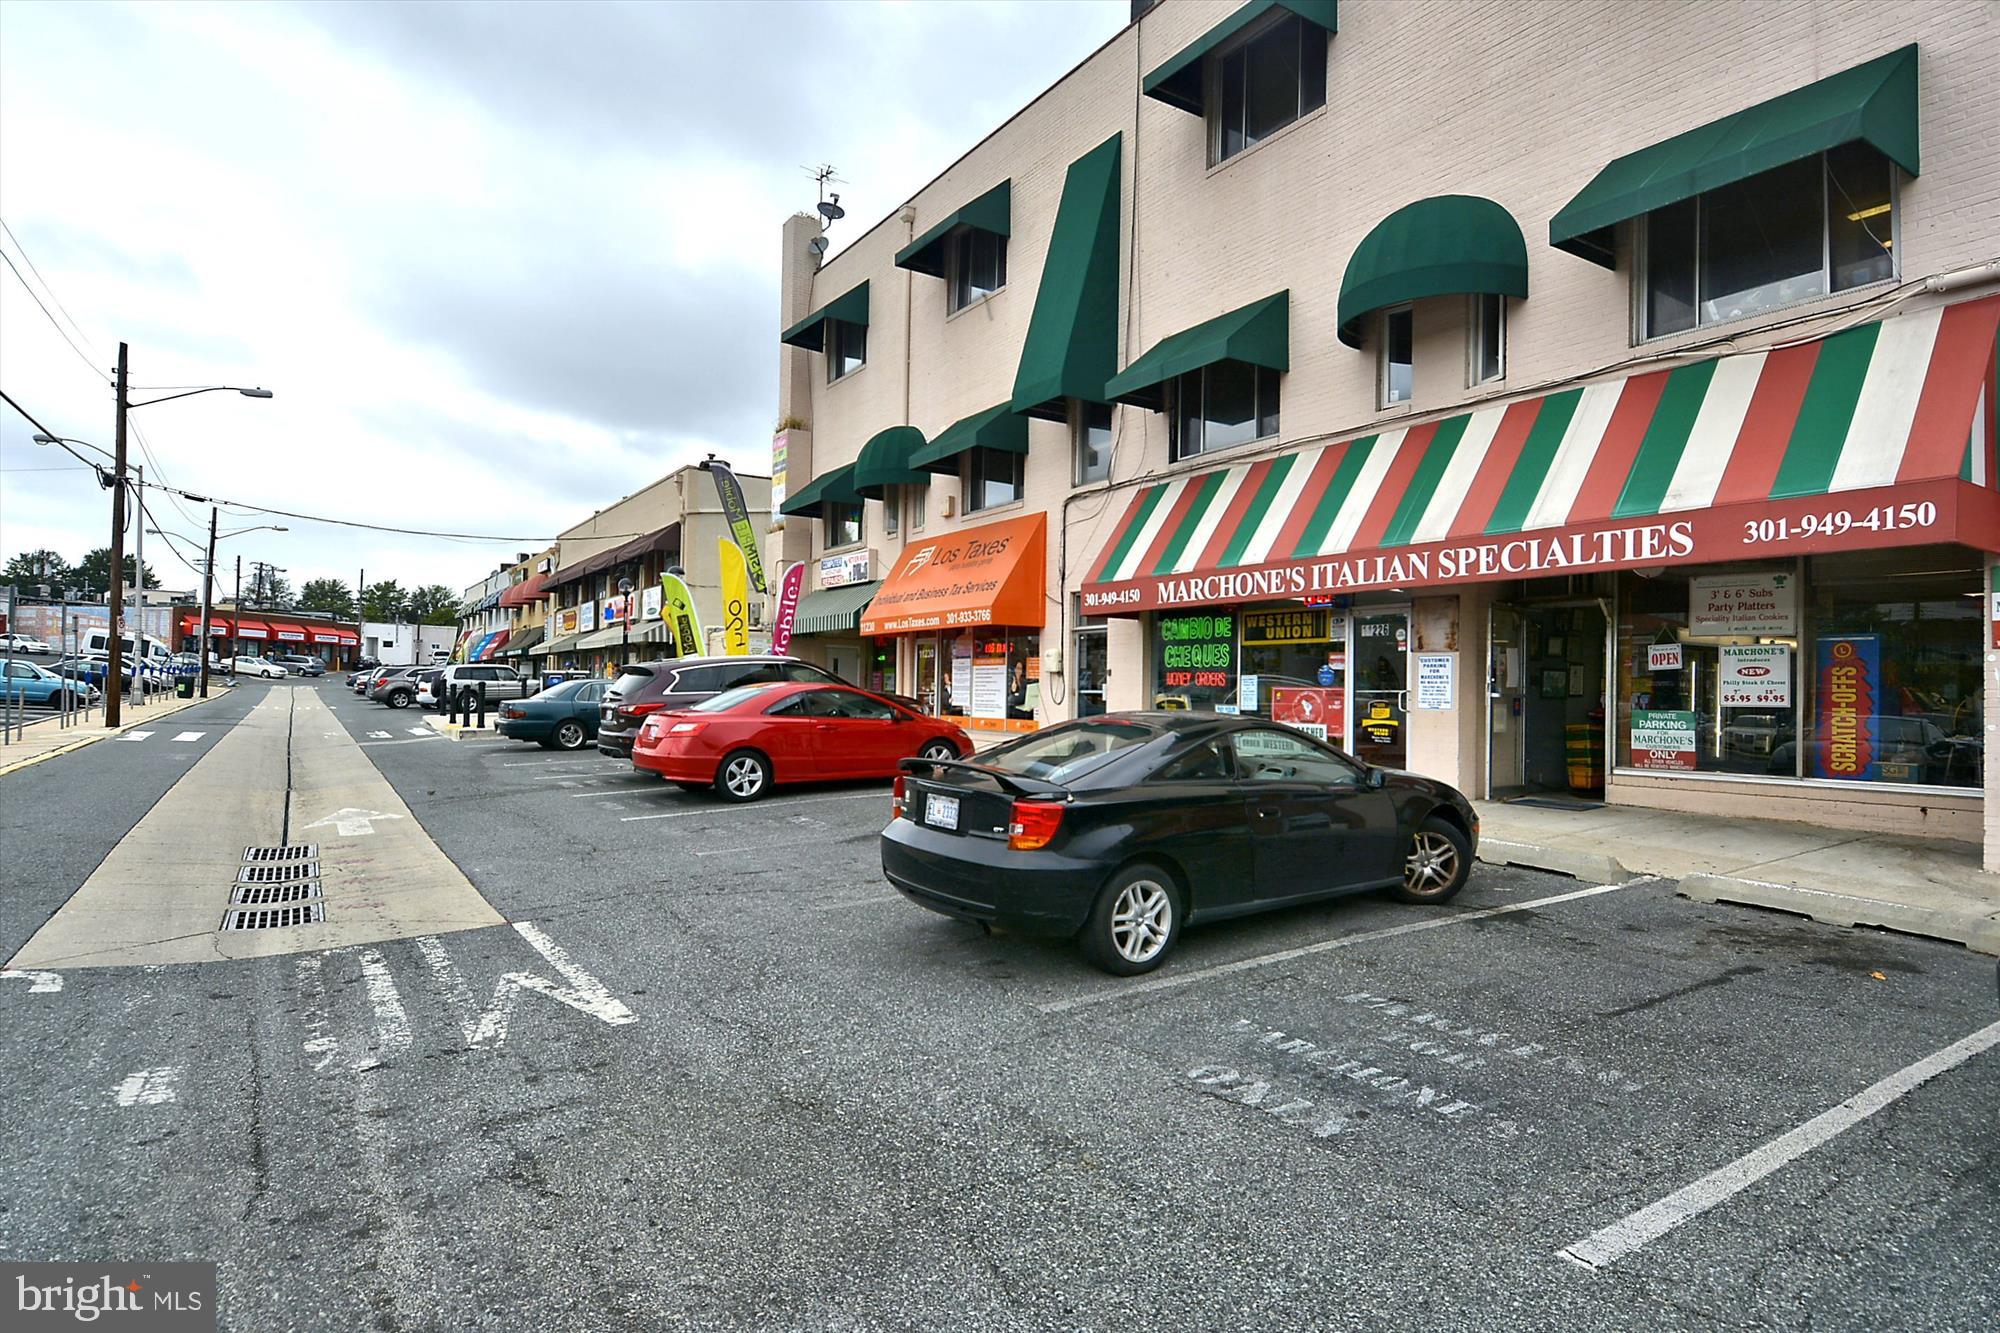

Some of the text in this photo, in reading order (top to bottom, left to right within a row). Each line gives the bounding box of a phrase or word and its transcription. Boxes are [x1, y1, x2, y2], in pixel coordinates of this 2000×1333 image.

[1743, 501, 1937, 544] 301-949-4150
[931, 546, 961, 566] Los
[963, 537, 1010, 560] Taxes
[1157, 520, 1695, 604] MARCHONE'S ITALIAN SPECIALTIES
[875, 592, 906, 606] Individual
[916, 587, 950, 600] Business
[948, 583, 963, 596] Tax
[962, 580, 998, 594] Services
[1084, 588, 1141, 607] 301-949-4150
[1749, 588, 1773, 598] Subs
[1708, 601, 1776, 613] Party Platters
[860, 609, 991, 632] 11230 www.LosTaxes.com 301-933-3766
[1246, 611, 1313, 628] WESTERN
[1733, 614, 1756, 622] Italian
[1759, 612, 1788, 621] Cookies
[679, 616, 695, 653] Mobile
[1161, 615, 1232, 640] CAMBIO DE
[1266, 625, 1313, 639] UNION
[1164, 643, 1230, 668] CHEQUES
[1651, 652, 1679, 666] OPEN
[1724, 648, 1785, 656] MARCHONE'S
[1166, 671, 1226, 687] MONEY ORDERS
[1724, 694, 1785, 703] $5.95 $9.95
[1648, 712, 1677, 720] PRIVATE
[1830, 666, 1858, 771] SCRATCH-OFFS
[1639, 720, 1687, 729] PARKING
[1634, 735, 1694, 746] MARCHONE'S
[1649, 750, 1678, 759] ONLY
